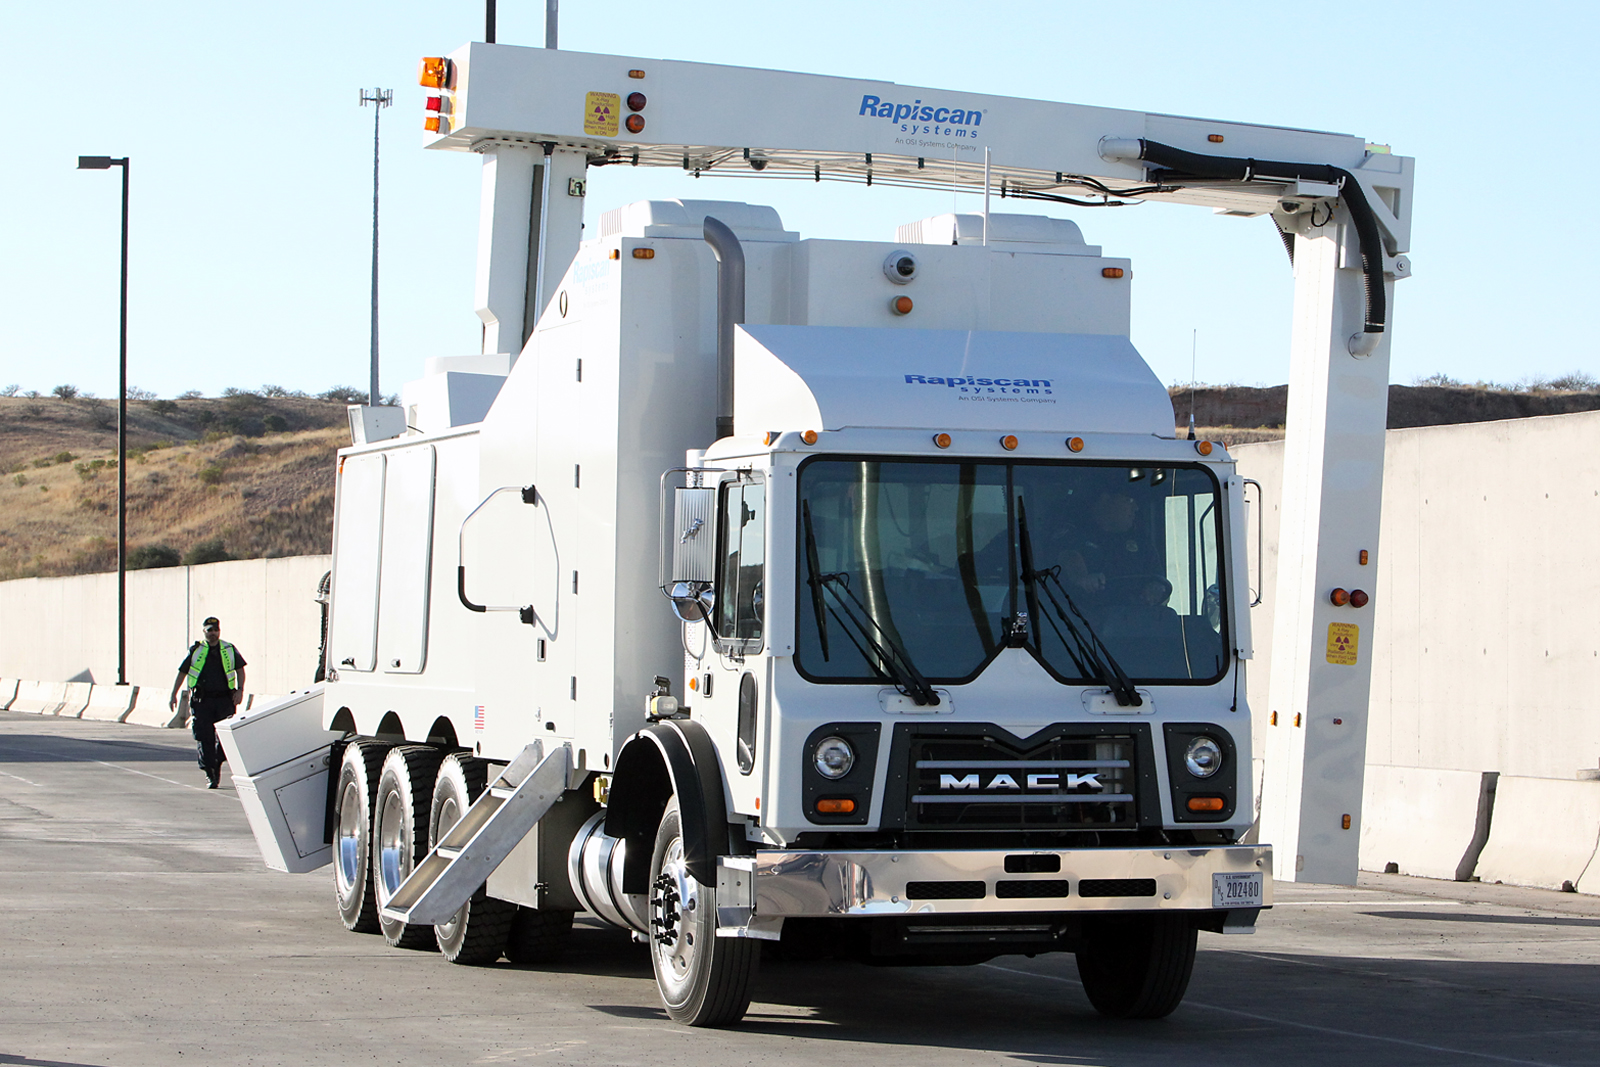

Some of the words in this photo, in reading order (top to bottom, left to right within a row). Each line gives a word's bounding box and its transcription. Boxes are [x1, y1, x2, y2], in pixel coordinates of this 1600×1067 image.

[859, 94, 983, 127] Rapiscan
[900, 123, 978, 139] systems
[905, 138, 918, 146] OSI
[919, 139, 946, 148] Systems
[946, 142, 977, 152] Company
[904, 374, 1051, 388] Rapiscan
[961, 386, 1053, 395] systems
[940, 774, 1104, 790] MACK
[1227, 881, 1259, 898] 202480
